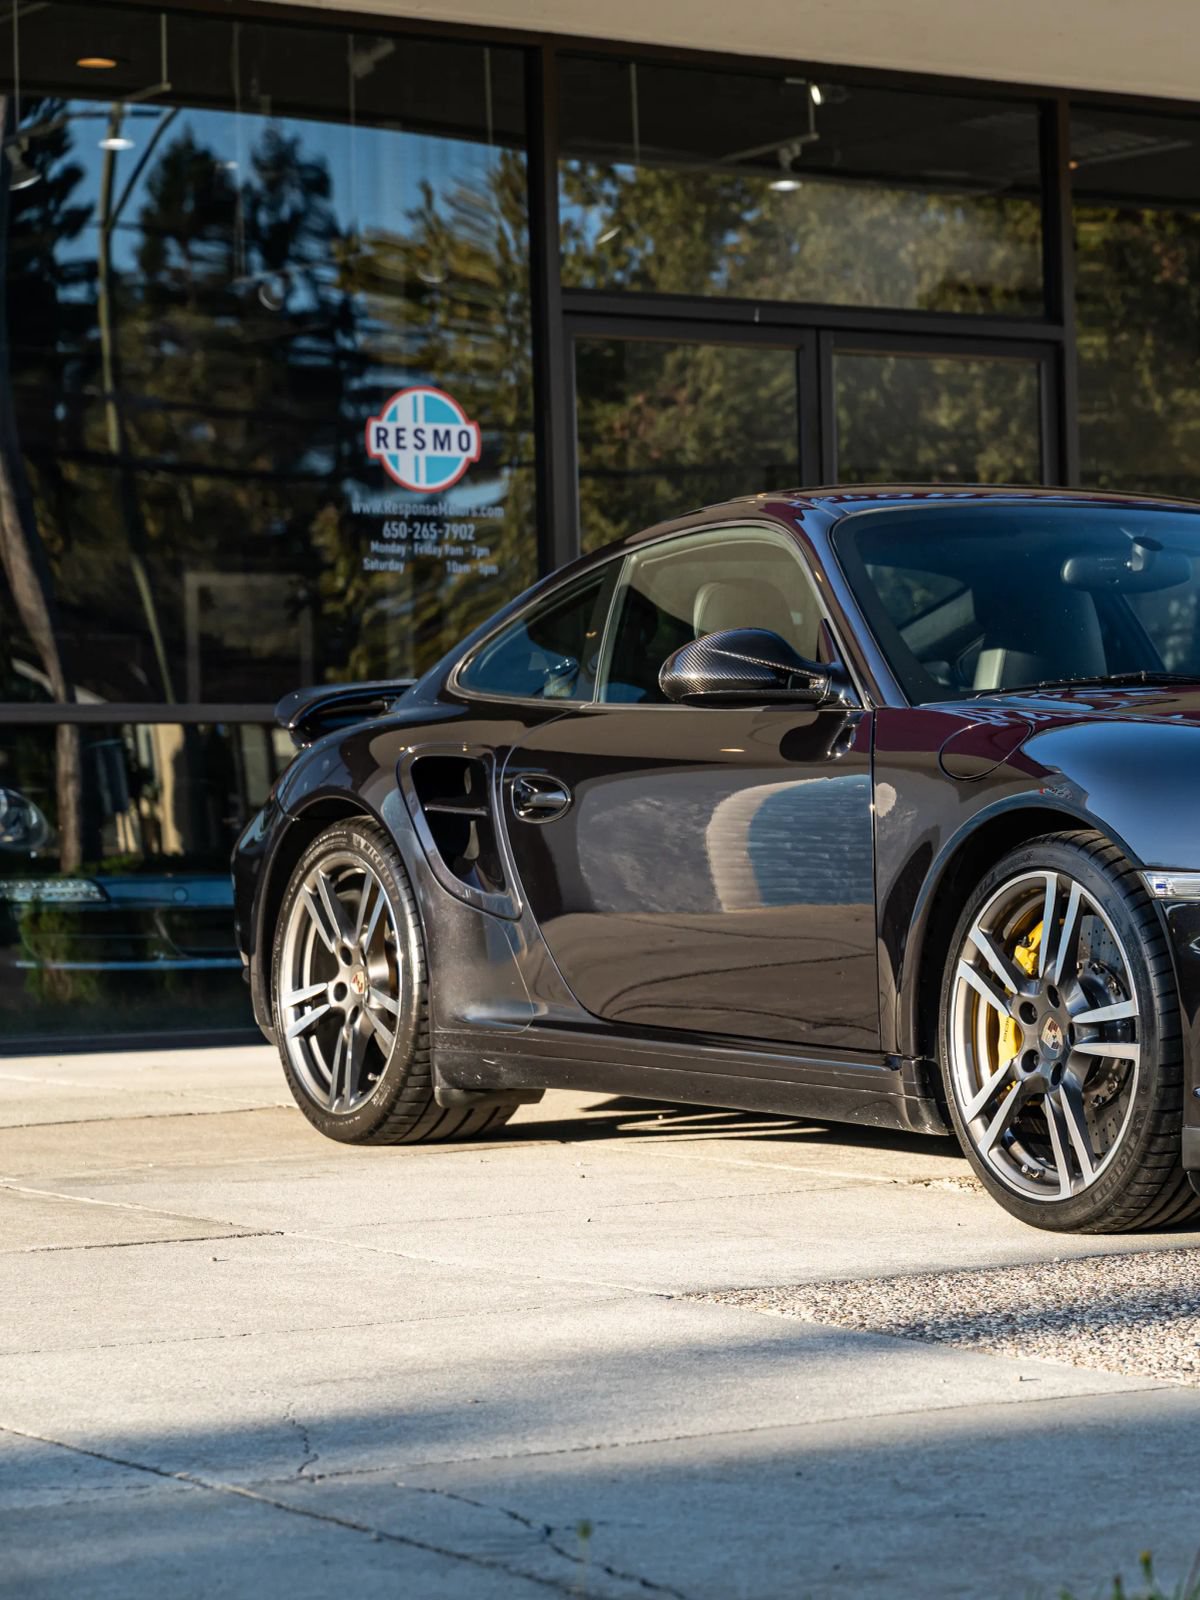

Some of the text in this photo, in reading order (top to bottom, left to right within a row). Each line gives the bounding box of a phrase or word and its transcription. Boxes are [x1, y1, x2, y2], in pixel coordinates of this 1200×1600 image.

[375, 426, 472, 453] RESMO
[382, 521, 475, 540] 650-265-7902
[370, 540, 406, 558] Monday
[414, 541, 443, 559] Friday
[363, 557, 405, 575] Saturday
